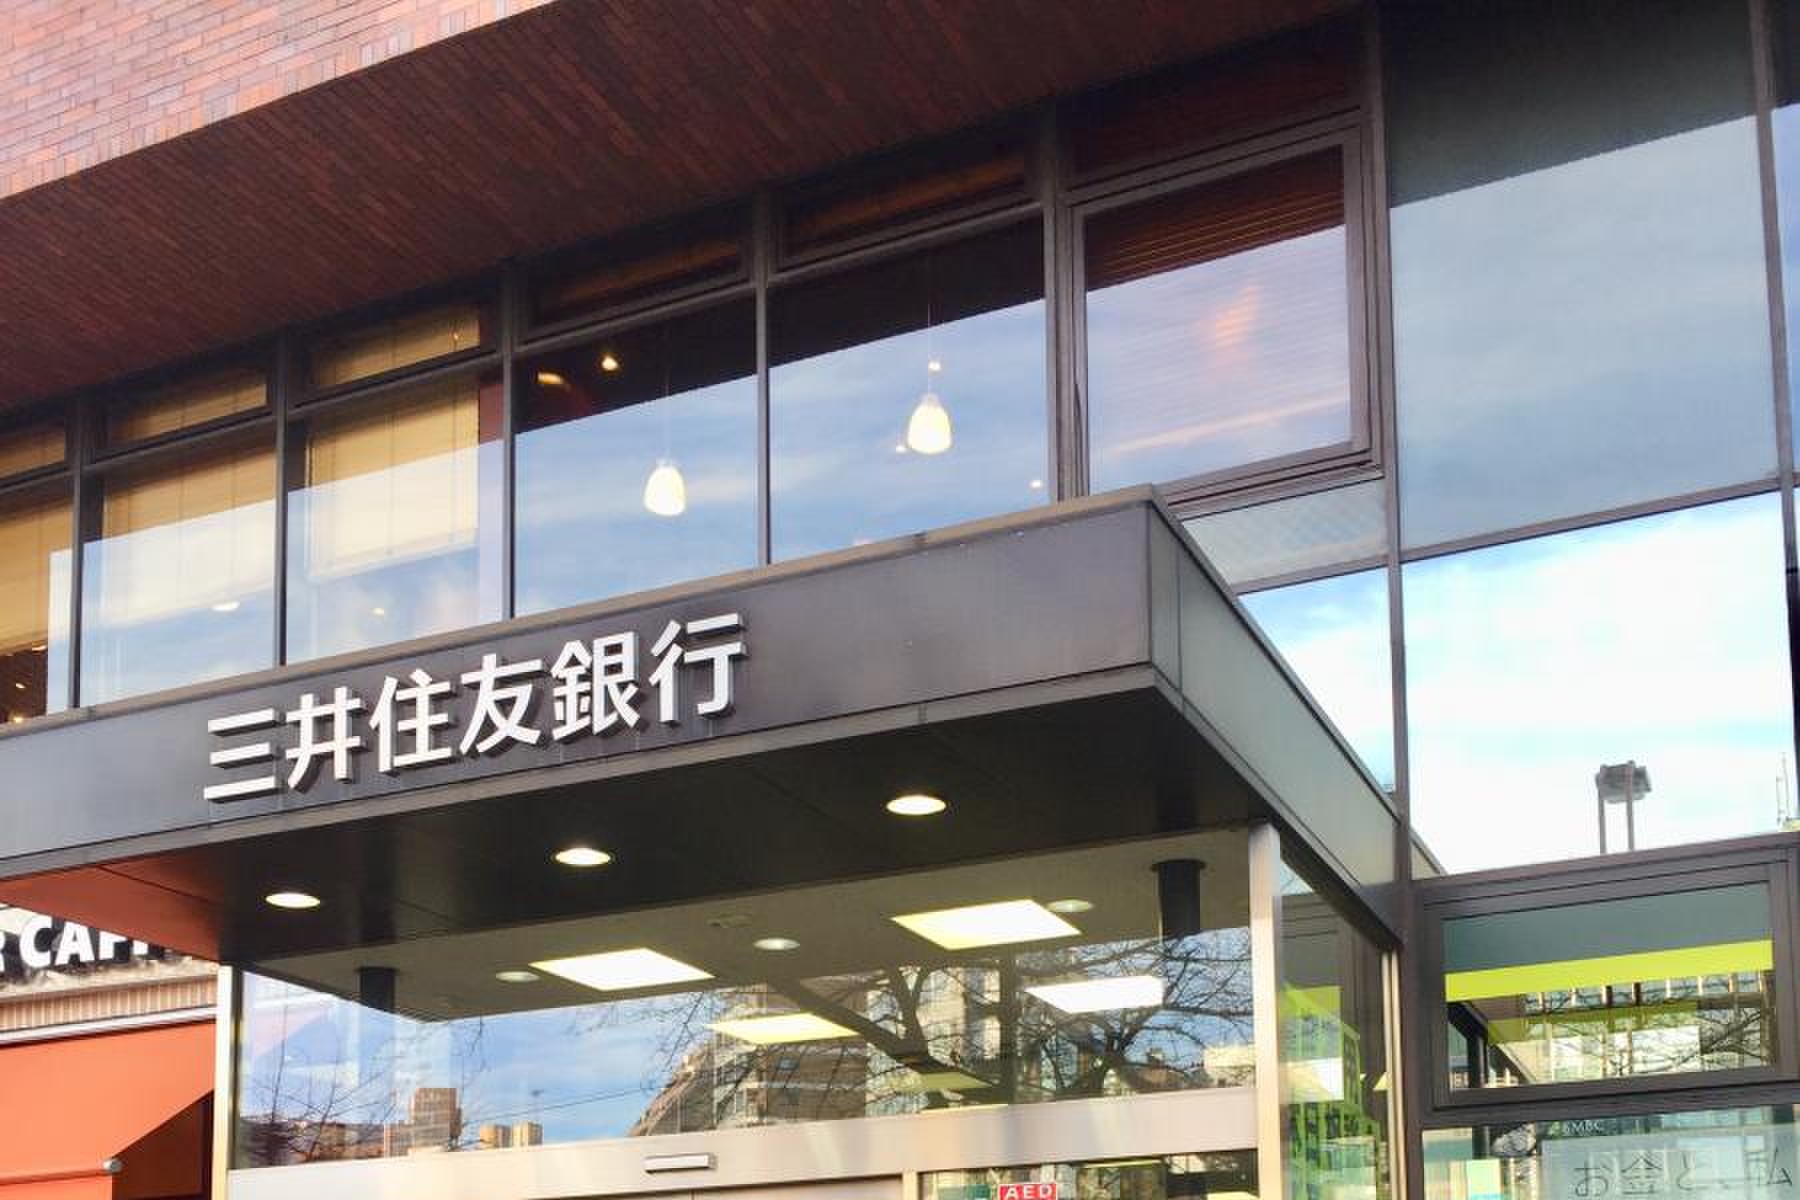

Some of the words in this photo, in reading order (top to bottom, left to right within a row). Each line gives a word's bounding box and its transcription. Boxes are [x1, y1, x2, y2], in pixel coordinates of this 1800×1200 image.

[203, 612, 748, 802] 三井住友銀行
[1004, 1185, 1052, 1200] AED
